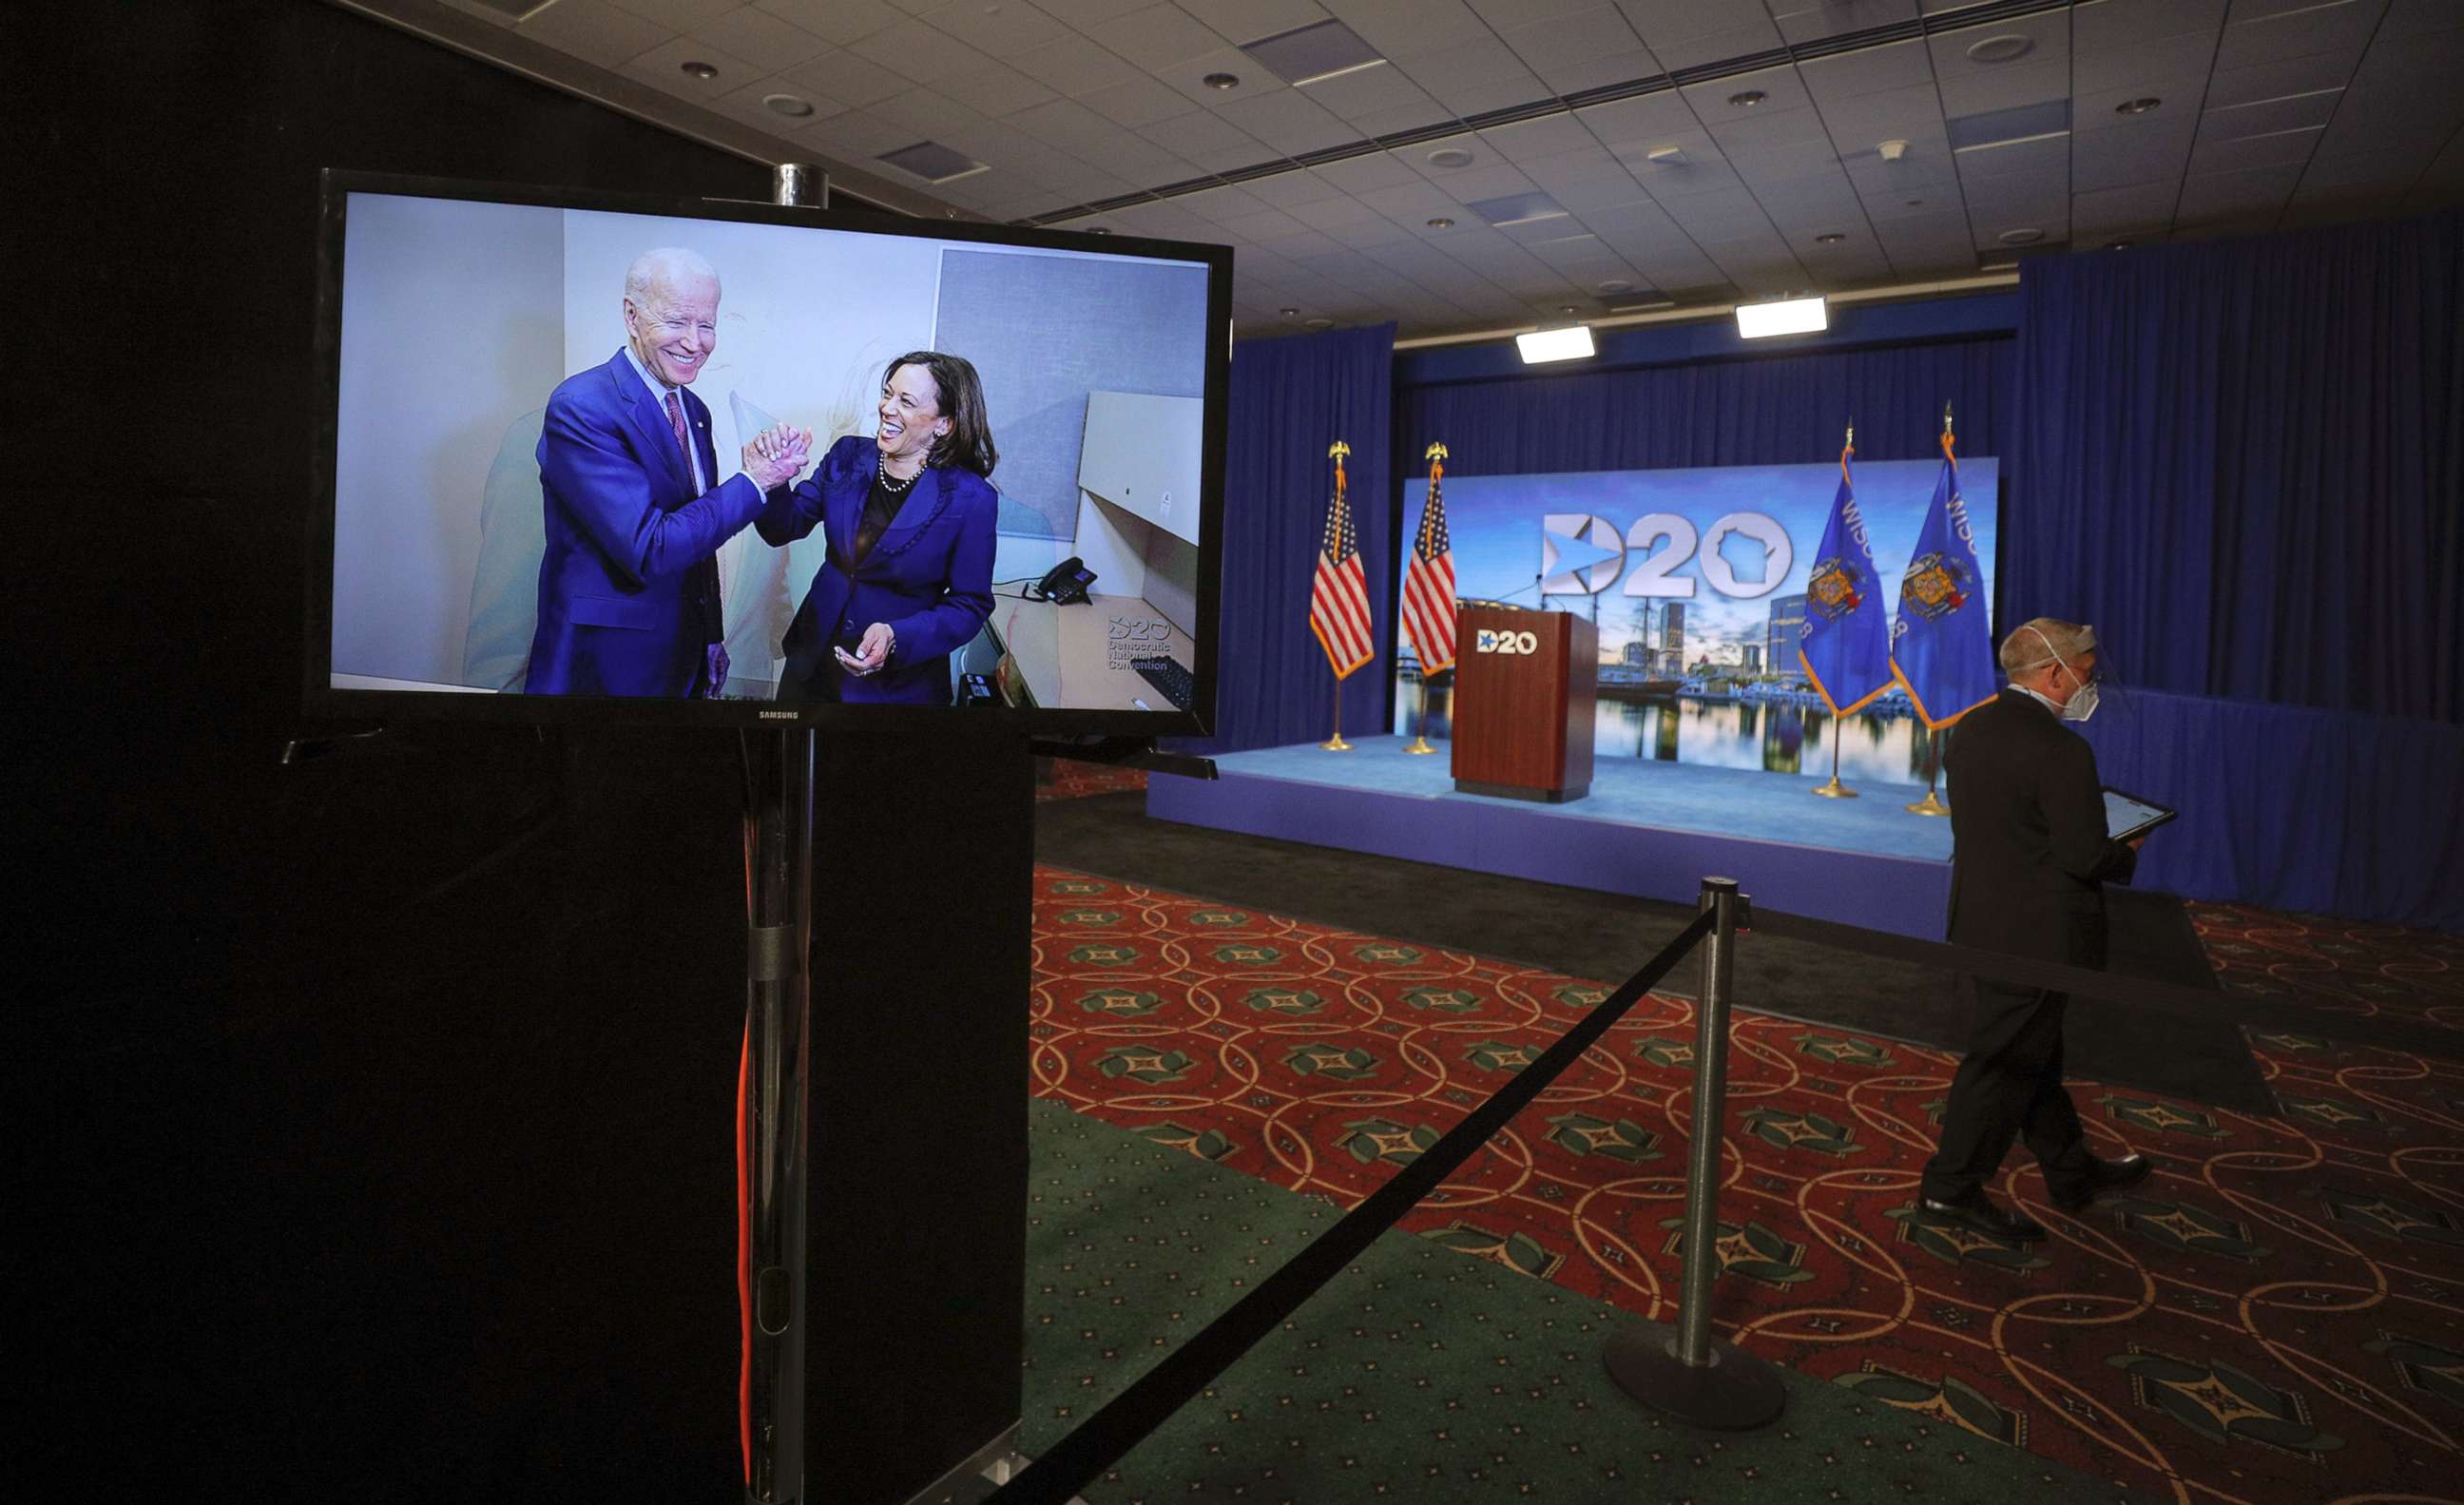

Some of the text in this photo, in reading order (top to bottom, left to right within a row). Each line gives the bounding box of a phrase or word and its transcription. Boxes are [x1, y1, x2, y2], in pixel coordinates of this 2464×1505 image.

[1541, 511, 1794, 599] D20
[1109, 641, 1171, 651] Democratic
[1476, 629, 1537, 655] D20
[1109, 651, 1155, 661] National
[1109, 660, 1168, 670] Convention
[759, 711, 799, 720] SAMSUNG
